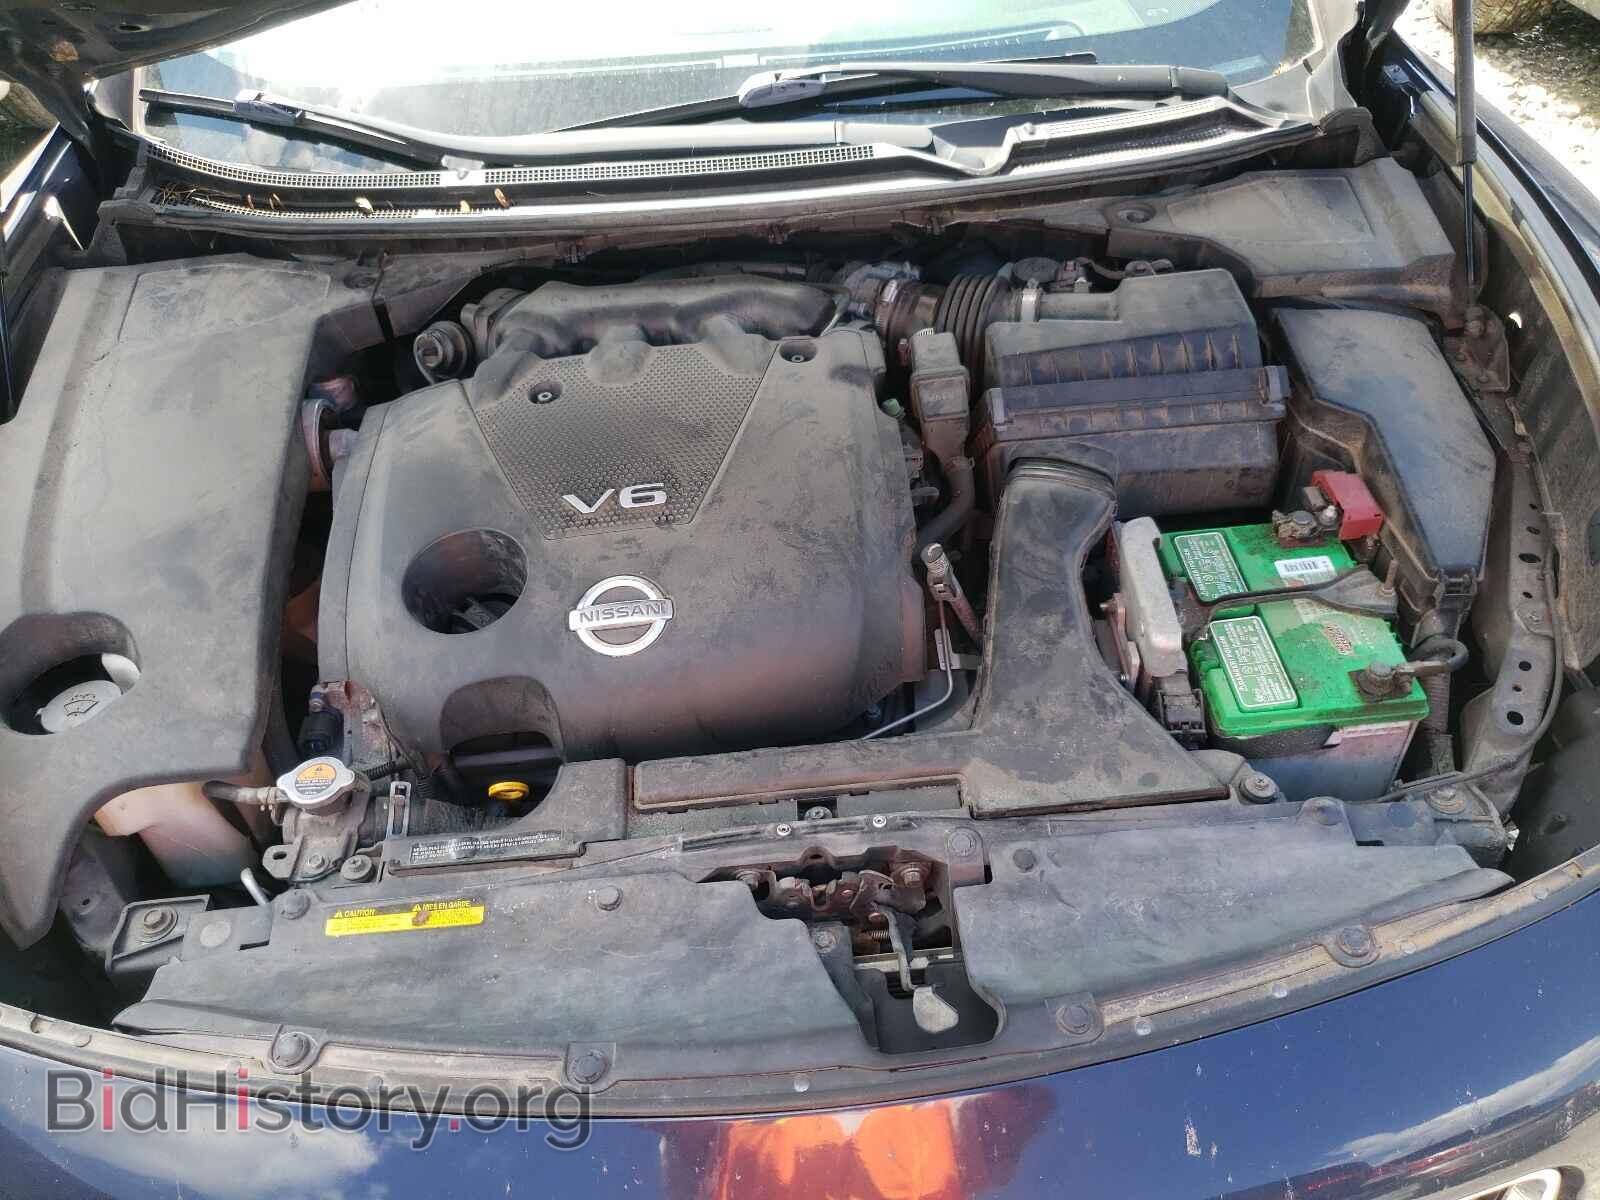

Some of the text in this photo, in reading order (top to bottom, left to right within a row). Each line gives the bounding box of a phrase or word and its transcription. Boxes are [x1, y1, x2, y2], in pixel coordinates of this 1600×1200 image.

[561, 482, 667, 514] V6
[579, 601, 666, 624] NISSAN
[344, 909, 376, 919] CAUTION
